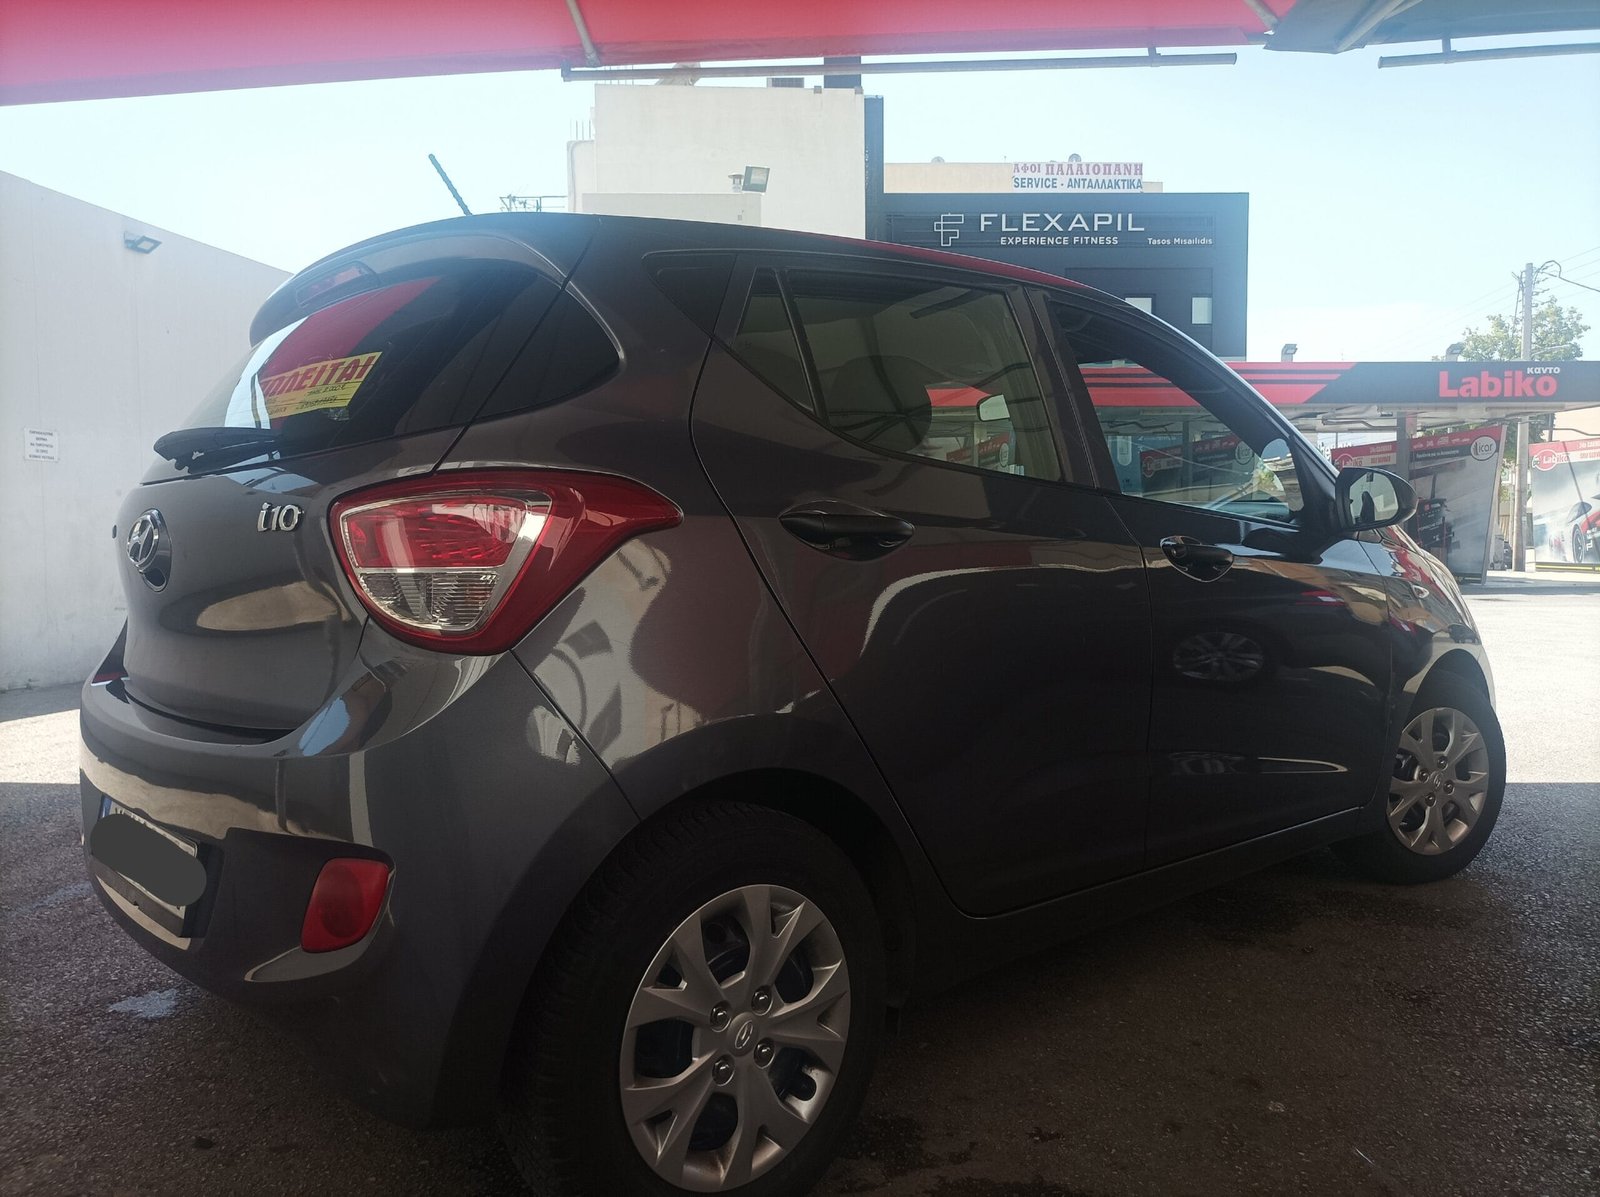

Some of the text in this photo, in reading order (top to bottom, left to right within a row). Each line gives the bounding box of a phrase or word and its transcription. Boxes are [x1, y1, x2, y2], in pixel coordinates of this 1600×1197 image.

[1013, 162, 1143, 176] ΑΦΟΙ ΠΑΛΑΙΟΠΑΝΗ
[1013, 177, 1057, 189] SERVICE
[1067, 177, 1143, 190] ΑΝΤΑΛΛΑΚΤΙΚΑ
[980, 213, 1145, 232] FLEXAPIL
[1000, 236, 1119, 245] EXPERIENCE FITNESS
[1147, 236, 1213, 245] Tasos Misailidis
[1439, 370, 1558, 398] Labiko
[257, 502, 300, 532] i10
